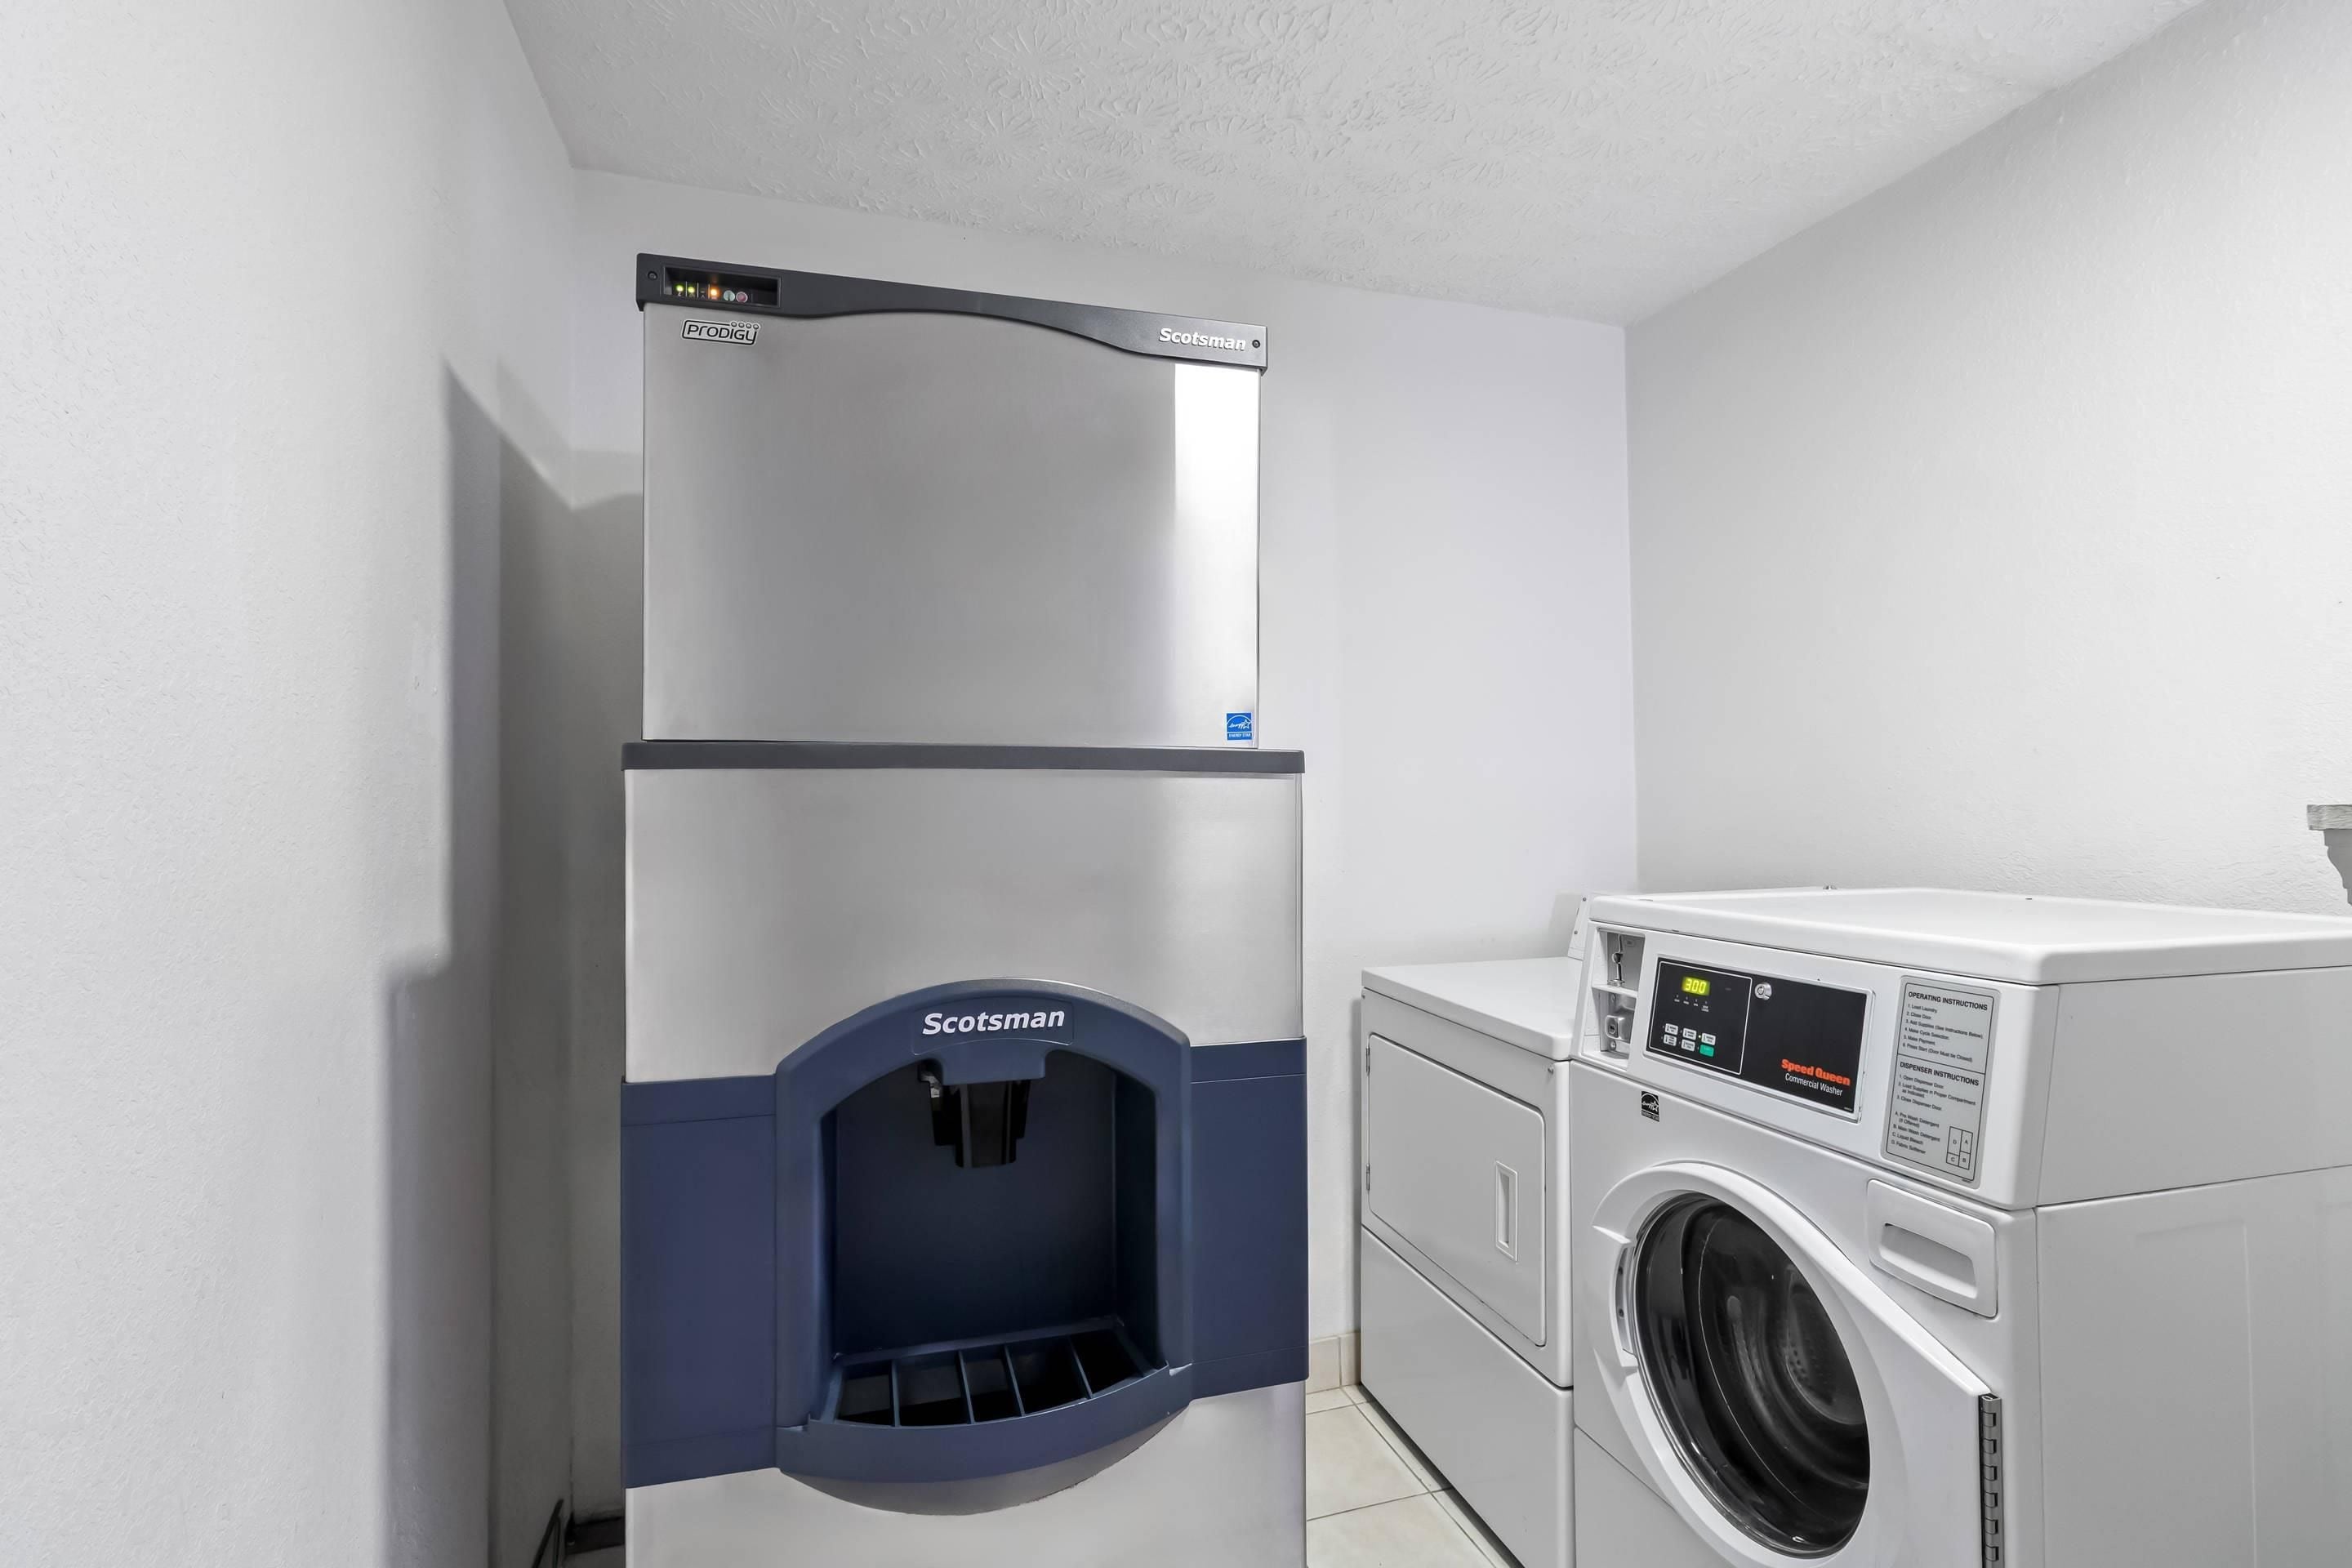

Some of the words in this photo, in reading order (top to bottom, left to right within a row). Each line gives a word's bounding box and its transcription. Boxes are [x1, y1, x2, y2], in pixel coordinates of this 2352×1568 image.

[1159, 327, 1246, 351] Scotsman
[1685, 978, 1707, 994] 300
[1908, 991, 1941, 1003] OPERATING
[1942, 997, 1988, 1011] INSTRUCTIONS
[922, 1010, 1065, 1035] Scotsman
[1781, 1058, 1815, 1076] Speed
[1815, 1067, 1851, 1086] Queen
[1785, 1072, 1819, 1089] Commercial
[1820, 1082, 1843, 1096] Washer
[1900, 1061, 1932, 1075] DISPENSER
[1933, 1070, 1979, 1086] INSTRUCTIONS
